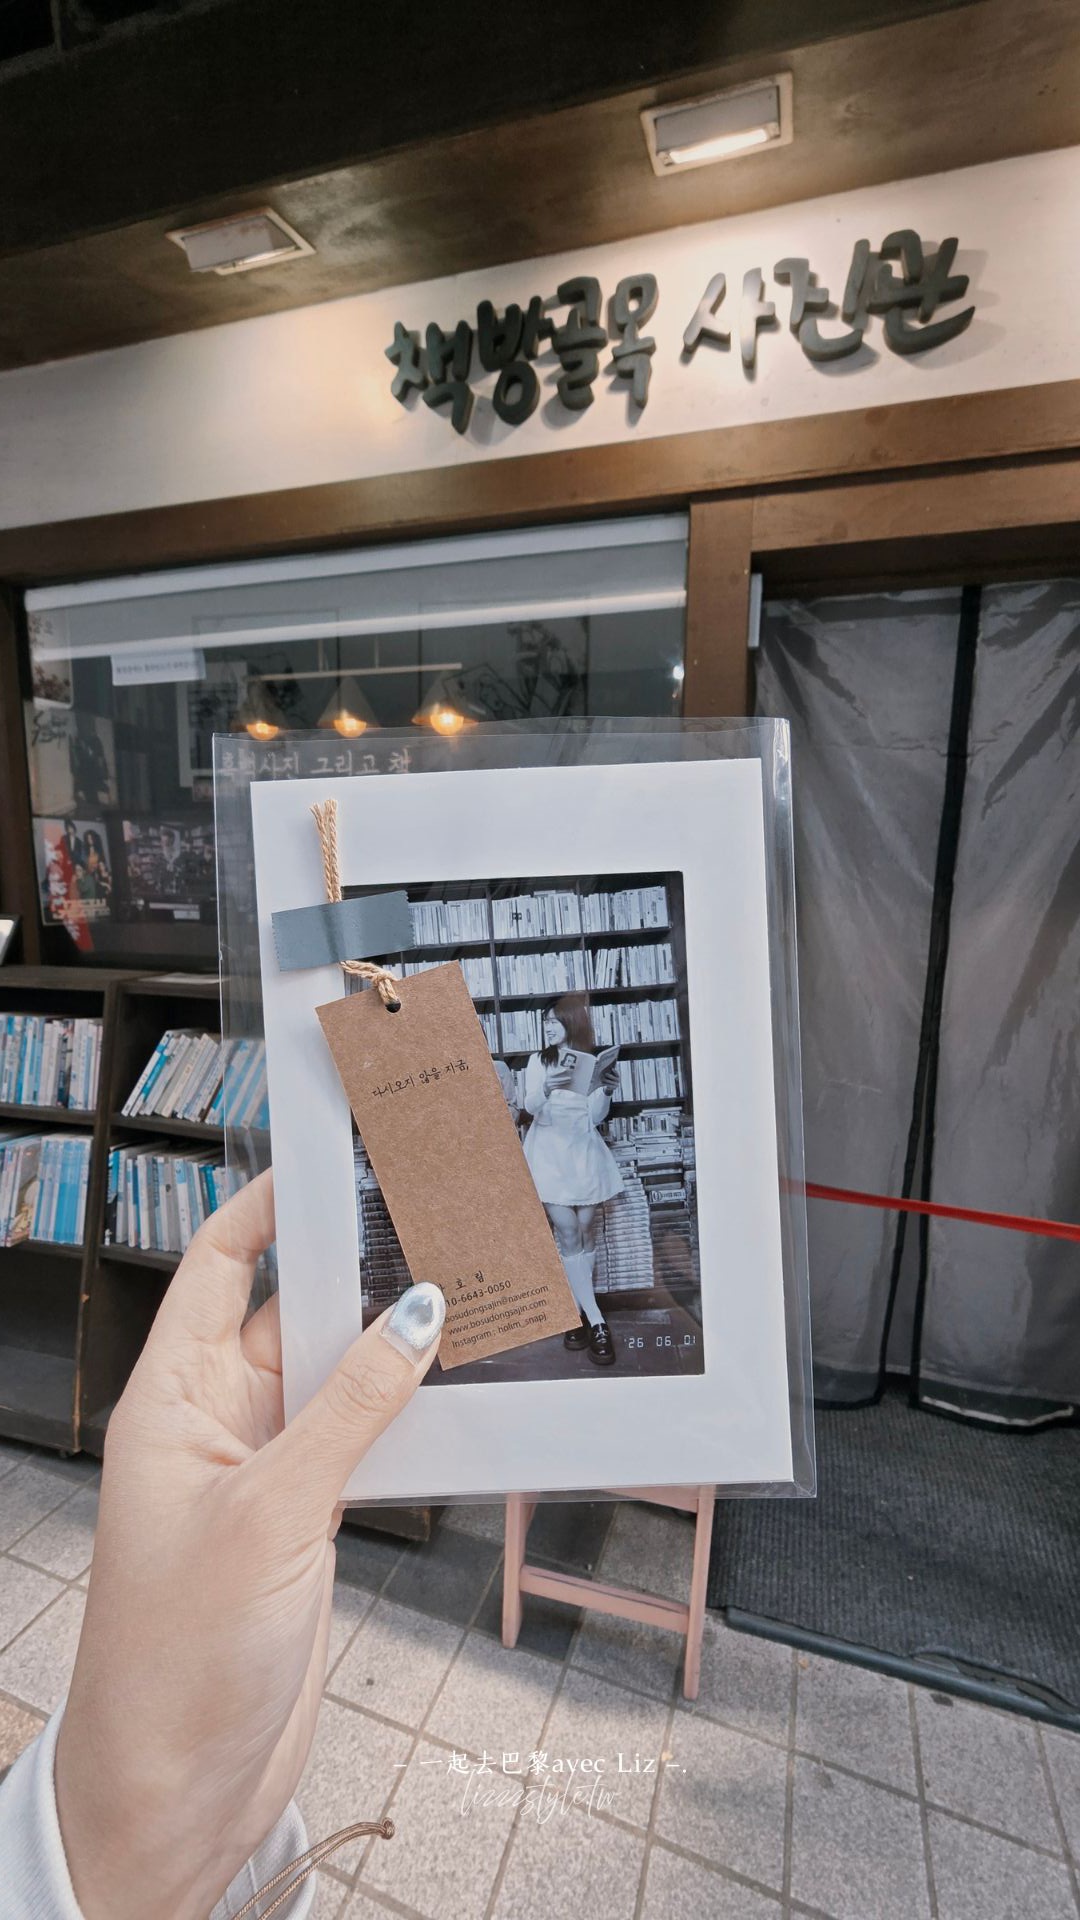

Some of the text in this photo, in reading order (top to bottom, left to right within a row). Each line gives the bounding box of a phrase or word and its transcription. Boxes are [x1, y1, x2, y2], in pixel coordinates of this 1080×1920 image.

[385, 229, 977, 434] 책방골목 사진관
[310, 750, 381, 776] 그리고
[419, 1067, 441, 1084] 않을
[445, 1280, 512, 1308] 10-6643-0050
[448, 1299, 548, 1336] www.bosudongsajin.com
[452, 1330, 493, 1348] Instagram
[656, 1335, 672, 1347] 06
[683, 1334, 696, 1346] 01
